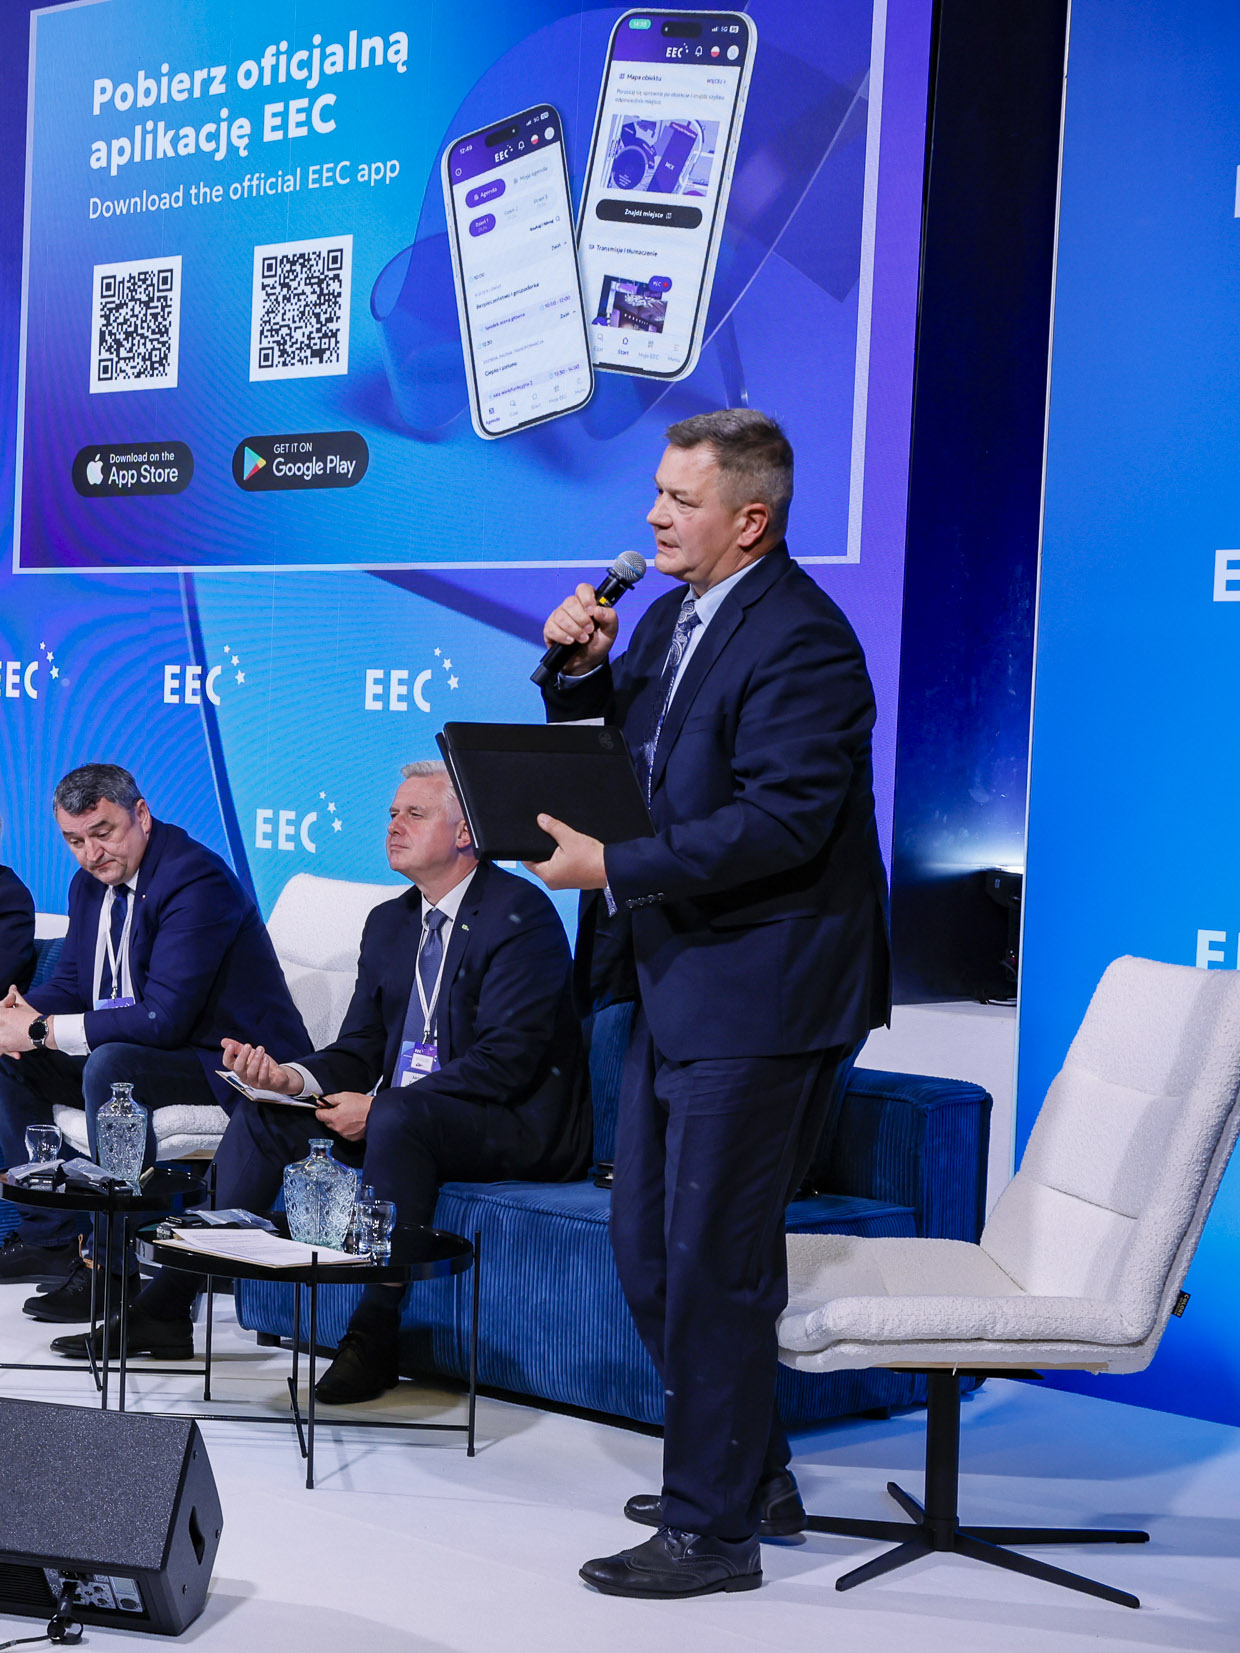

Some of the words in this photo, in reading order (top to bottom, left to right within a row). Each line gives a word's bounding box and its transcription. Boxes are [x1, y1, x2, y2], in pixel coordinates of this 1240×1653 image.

[666, 46, 683, 58] EEC
[92, 62, 227, 116] Pobierz
[236, 29, 409, 90] oficjalną
[89, 106, 252, 177] aplikację
[263, 93, 337, 142] EEC
[494, 150, 510, 162] EEC
[89, 184, 184, 219] Download
[190, 180, 224, 205] the
[229, 167, 301, 200] official
[308, 160, 351, 189] EEC
[357, 159, 400, 186] app
[109, 453, 148, 465] Download
[149, 454, 160, 463] on
[161, 451, 175, 462] the
[273, 443, 289, 454] GET
[290, 442, 298, 453] IT
[299, 442, 313, 453] ON
[108, 467, 139, 488] App
[140, 464, 178, 483] Store
[273, 457, 324, 480] Google
[327, 456, 356, 478] Play
[163, 664, 222, 706] EEC
[364, 669, 432, 713] EEC
[255, 808, 318, 854] EEC
